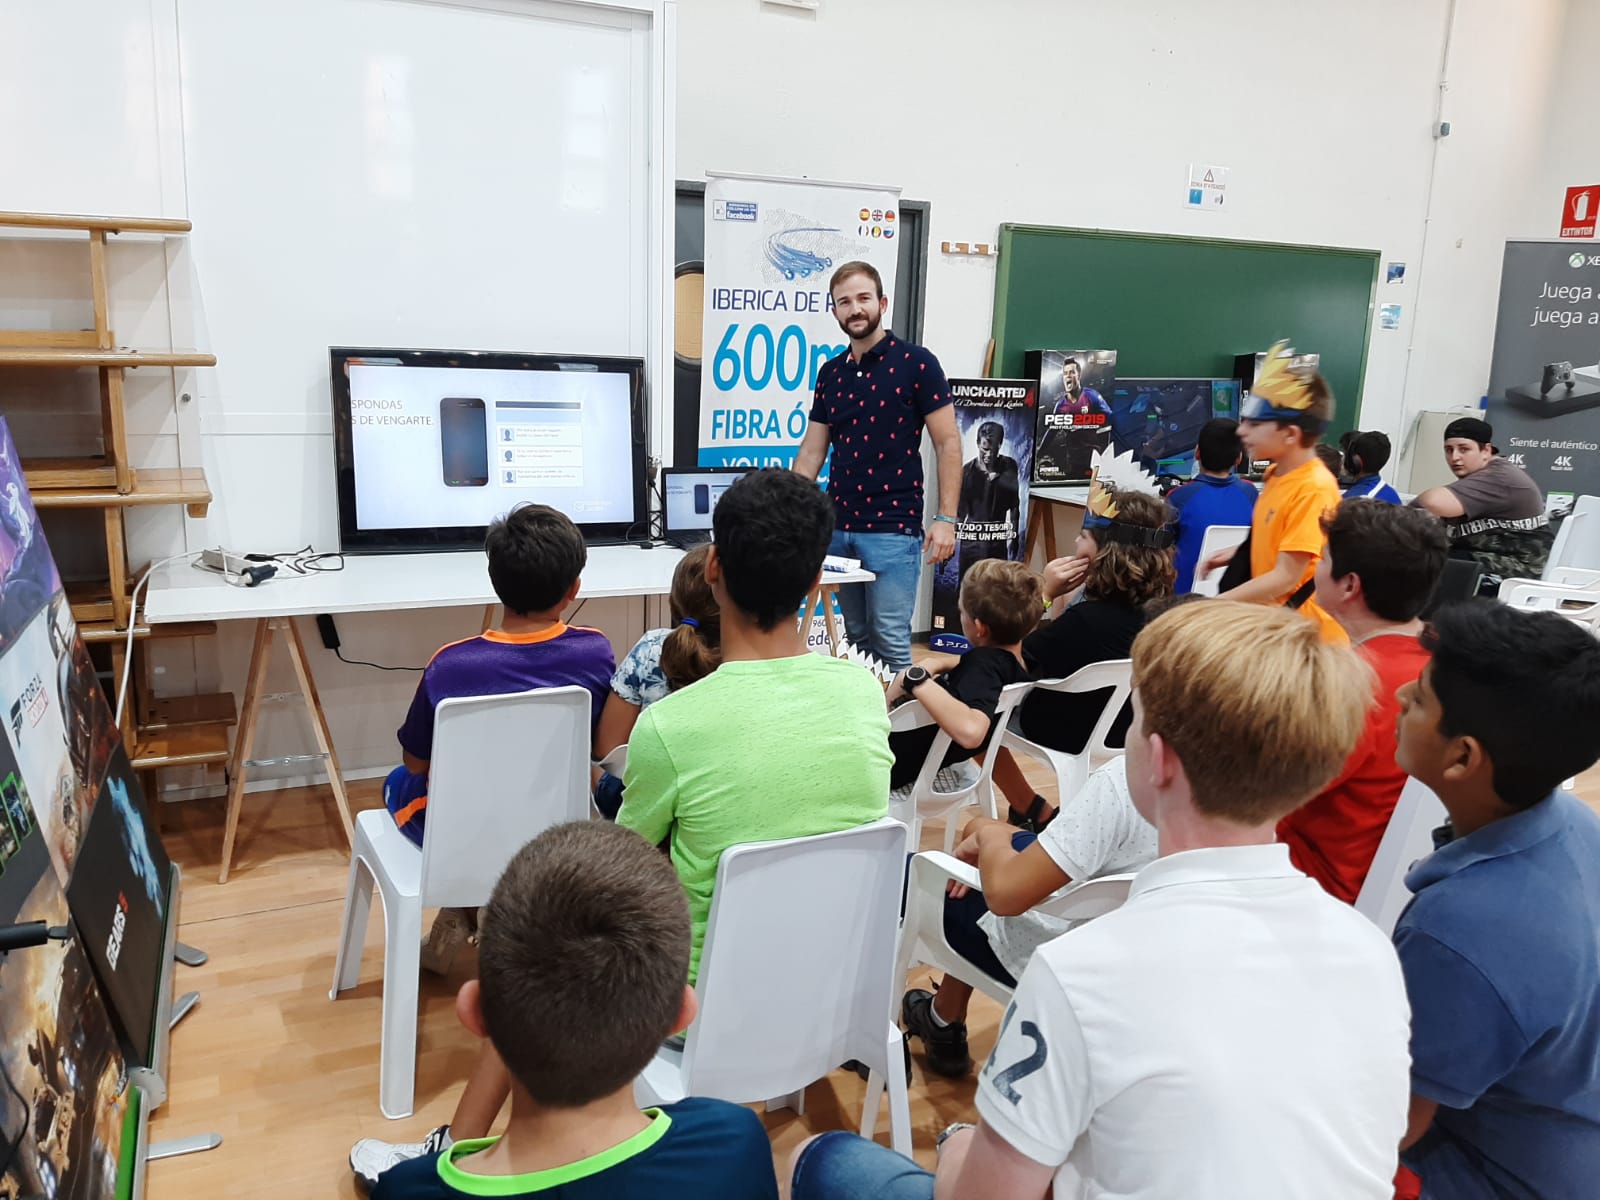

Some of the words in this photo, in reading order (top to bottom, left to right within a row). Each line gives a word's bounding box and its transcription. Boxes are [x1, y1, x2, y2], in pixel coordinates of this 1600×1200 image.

[1539, 282, 1593, 304] Juega
[712, 288, 788, 312] IBERICA
[794, 291, 819, 313] DE
[1530, 306, 1583, 328] juega
[952, 385, 1026, 398] UNCHARTED
[351, 399, 403, 410] SPONDAS
[360, 415, 374, 425] DE
[711, 409, 781, 440] FIBRA
[1045, 415, 1073, 425] PES
[1074, 414, 1105, 425] 2019
[1509, 437, 1539, 448] Siente
[1540, 438, 1550, 448] el
[1550, 439, 1598, 451] auténtico
[1508, 453, 1525, 465] 4K
[1554, 455, 1573, 467] 4K
[957, 522, 983, 532] TODO
[978, 532, 991, 541] UN
[983, 1000, 1048, 1107] 2
